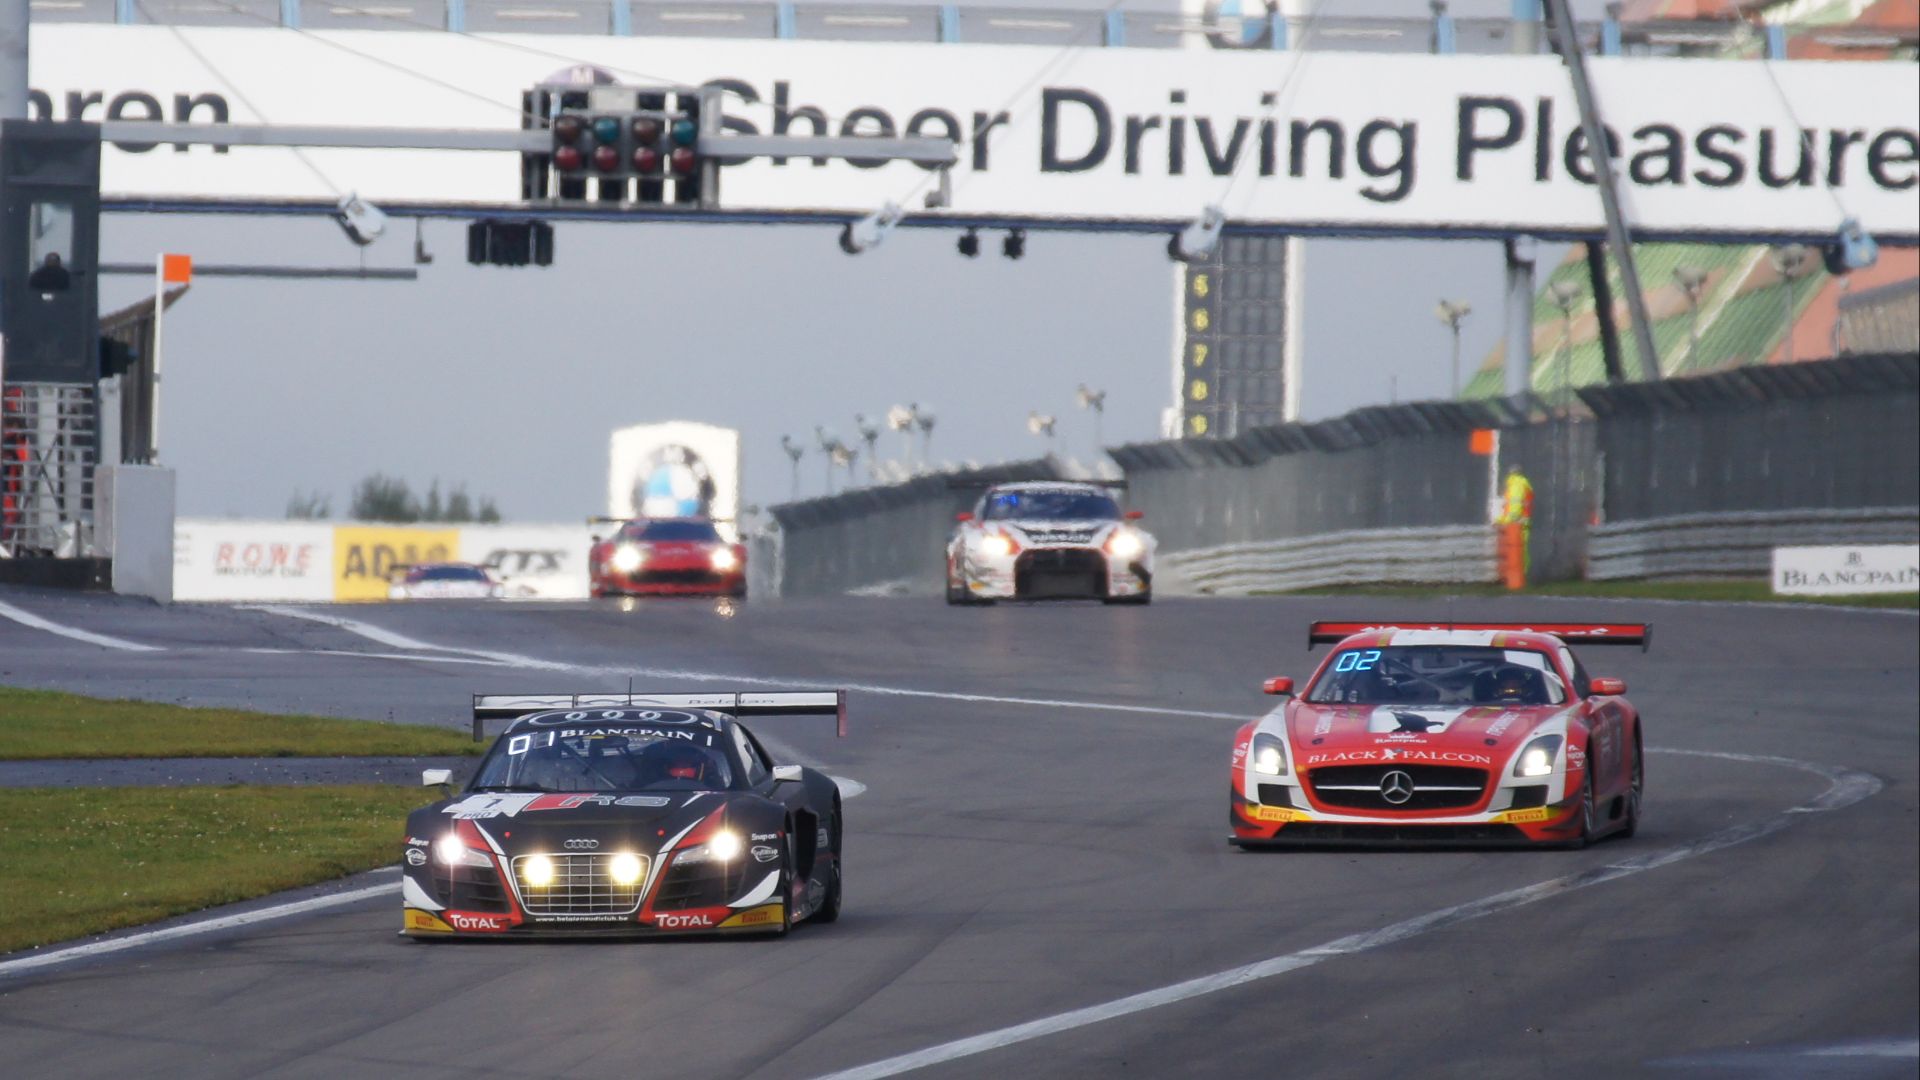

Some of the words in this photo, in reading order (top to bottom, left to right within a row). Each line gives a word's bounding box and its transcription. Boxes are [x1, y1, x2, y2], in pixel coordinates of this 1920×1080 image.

[700, 78, 1010, 171] Sheer
[1041, 87, 1417, 203] Driving
[1455, 94, 1919, 191] Pleasure
[1192, 343, 1208, 367] 7
[214, 543, 313, 568] ROWE
[1783, 566, 1919, 587] BLANCPAIN
[1335, 650, 1382, 673] 02
[560, 728, 696, 741] BLANCPAIN
[1307, 751, 1378, 764] BLACK
[1402, 751, 1492, 764] FALCON
[450, 914, 500, 929] TOTAL
[655, 913, 713, 928] TOTAL
